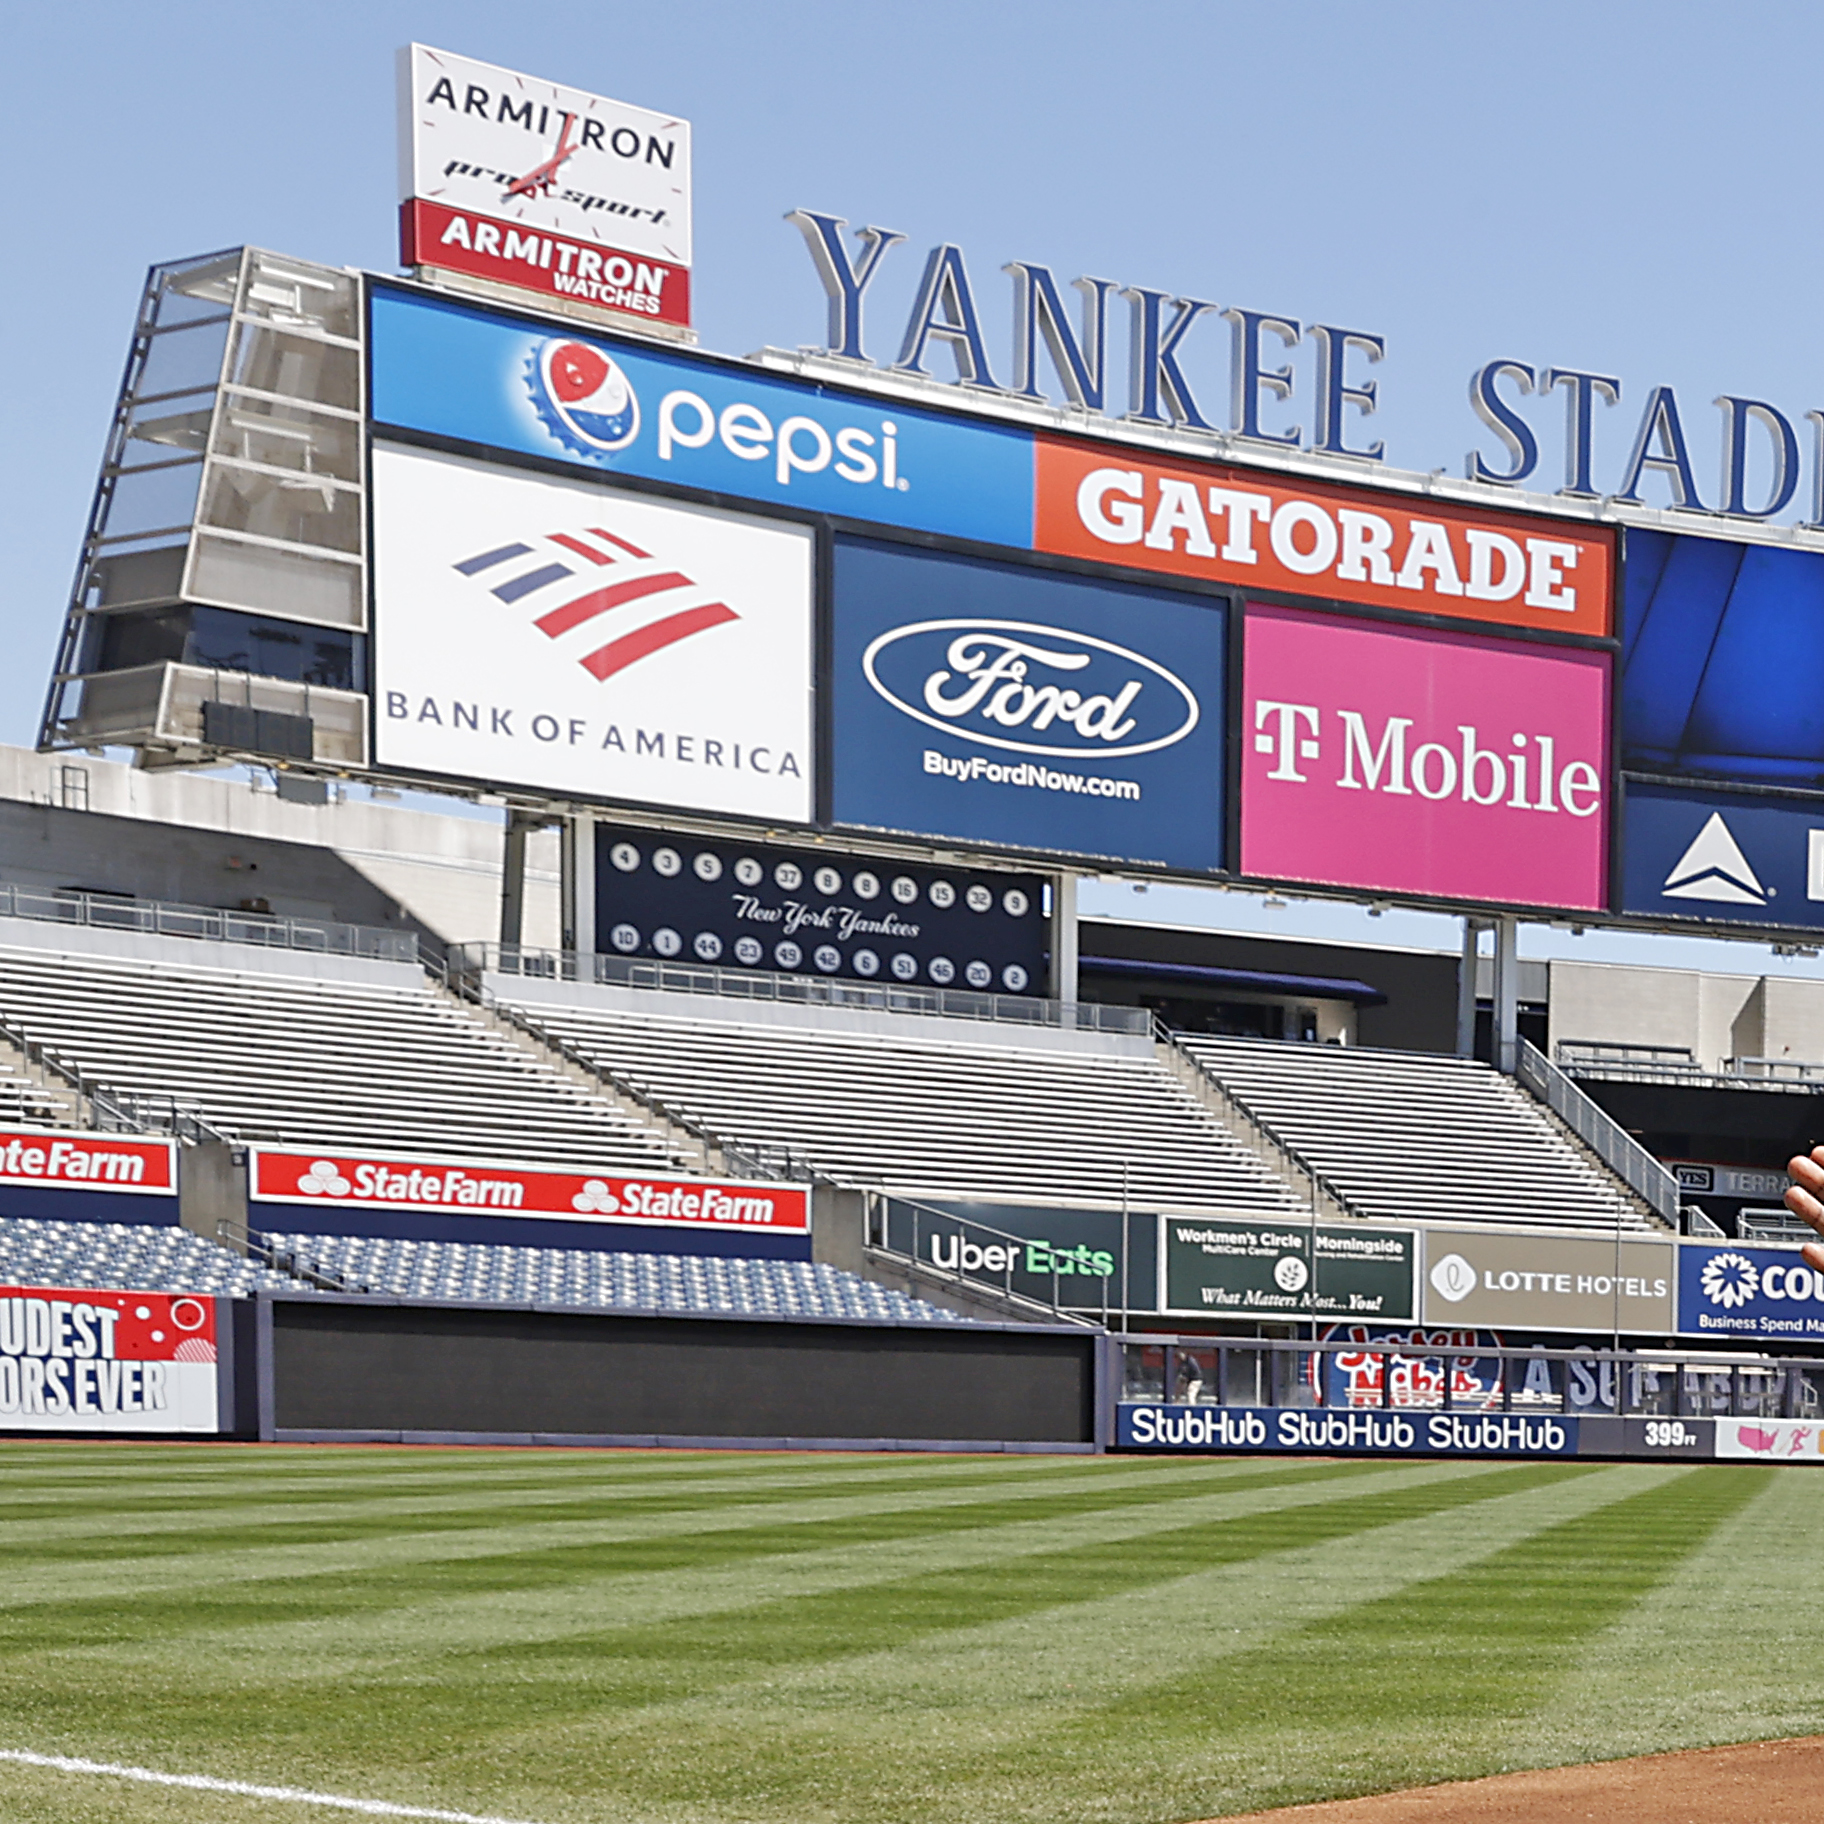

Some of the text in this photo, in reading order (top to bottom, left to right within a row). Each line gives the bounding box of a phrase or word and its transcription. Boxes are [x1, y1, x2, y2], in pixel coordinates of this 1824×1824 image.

[427, 76, 674, 169] ARMITRON
[441, 216, 667, 296] ARMITRON
[553, 272, 661, 314] WATCHES
[784, 207, 1385, 463] YANKEE
[658, 390, 898, 490] pepsi
[1077, 468, 1578, 612] GATORADE
[924, 633, 1143, 741] Ford
[386, 691, 802, 779] BANK OF AMERICA
[922, 750, 1141, 800] BuyFordNow.com
[732, 893, 920, 941] New York Yankees
[1679, 1171, 1708, 1184] YES
[931, 1233, 1114, 1277] Uber Eats
[1176, 1228, 1302, 1248] Workmen's Circle
[1316, 1236, 1404, 1254] Morningside
[1201, 1287, 1241, 1305] What
[1243, 1289, 1297, 1308] Matters
[1484, 1269, 1667, 1298] LOTTE HOTELS
[1699, 1313, 1757, 1330] Business
[1759, 1316, 1803, 1333] Spend
[75, 1359, 167, 1416] EVER
[1131, 1409, 1565, 1452] StubHub StubHub StubHub
